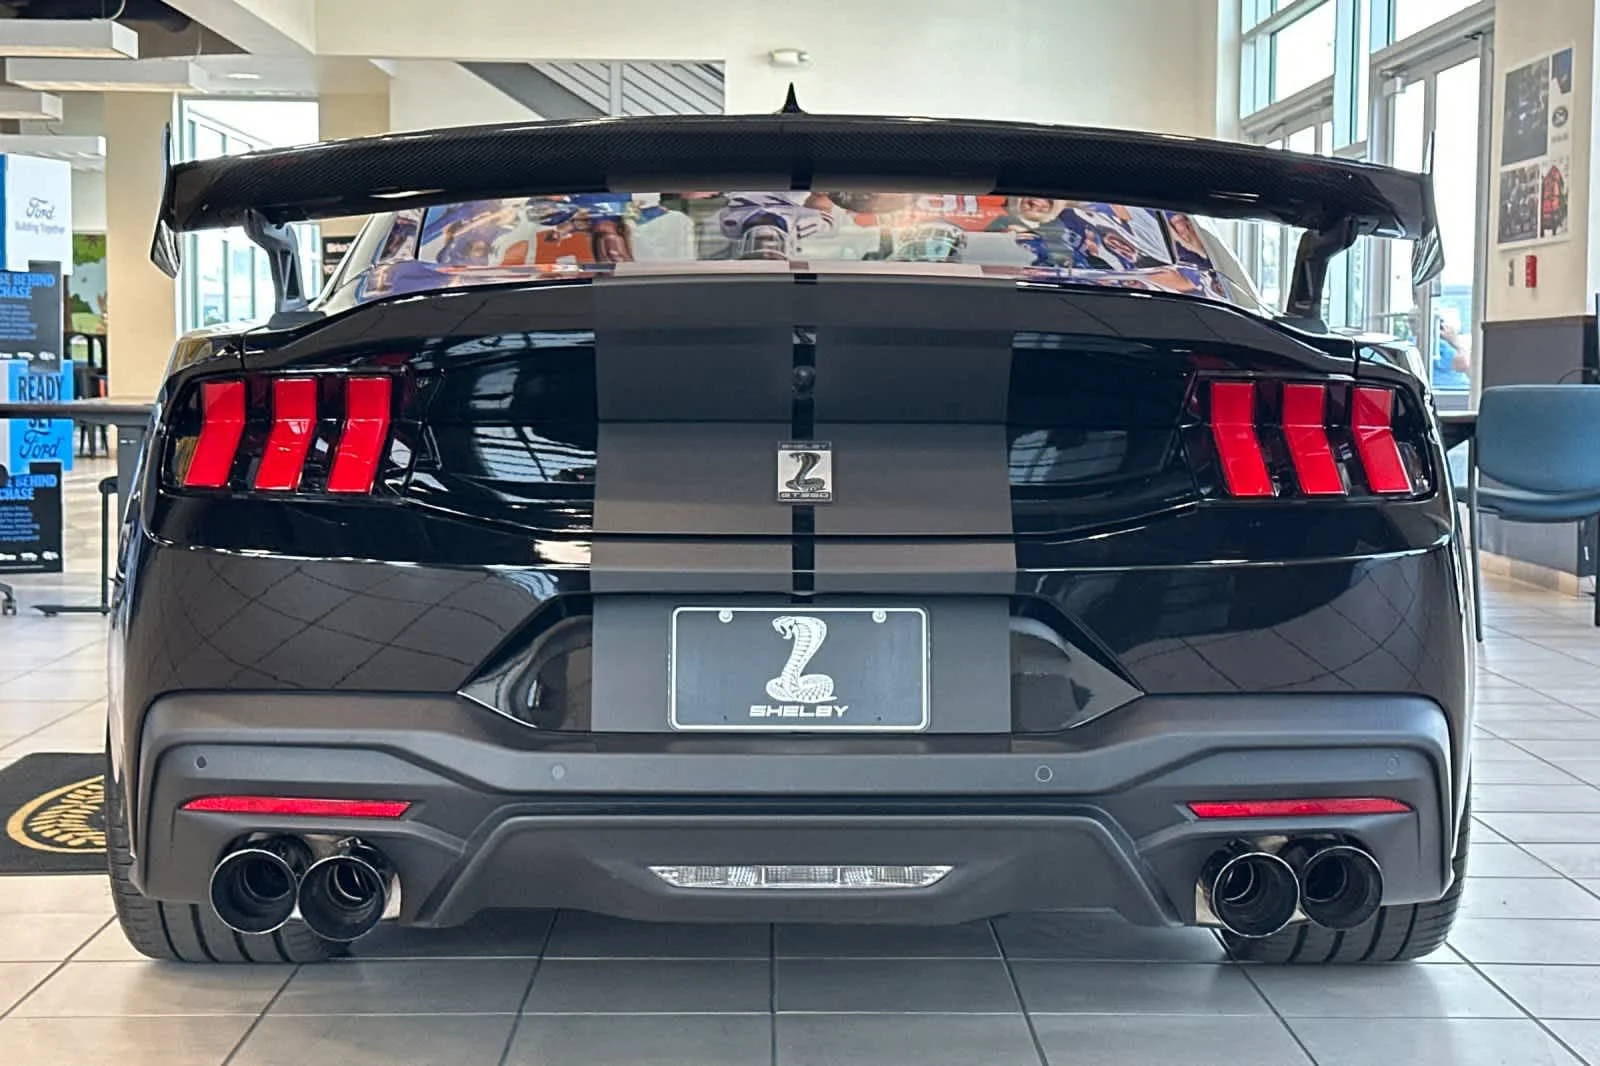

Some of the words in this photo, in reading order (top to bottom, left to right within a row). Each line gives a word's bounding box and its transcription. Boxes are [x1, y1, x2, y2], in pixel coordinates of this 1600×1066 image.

[26, 197, 56, 219] Ford
[13, 273, 56, 288] BEHIND
[18, 375, 64, 401] READY
[20, 430, 64, 458] Ford
[15, 473, 57, 488] BEHIND
[749, 705, 849, 717] SHELBY
